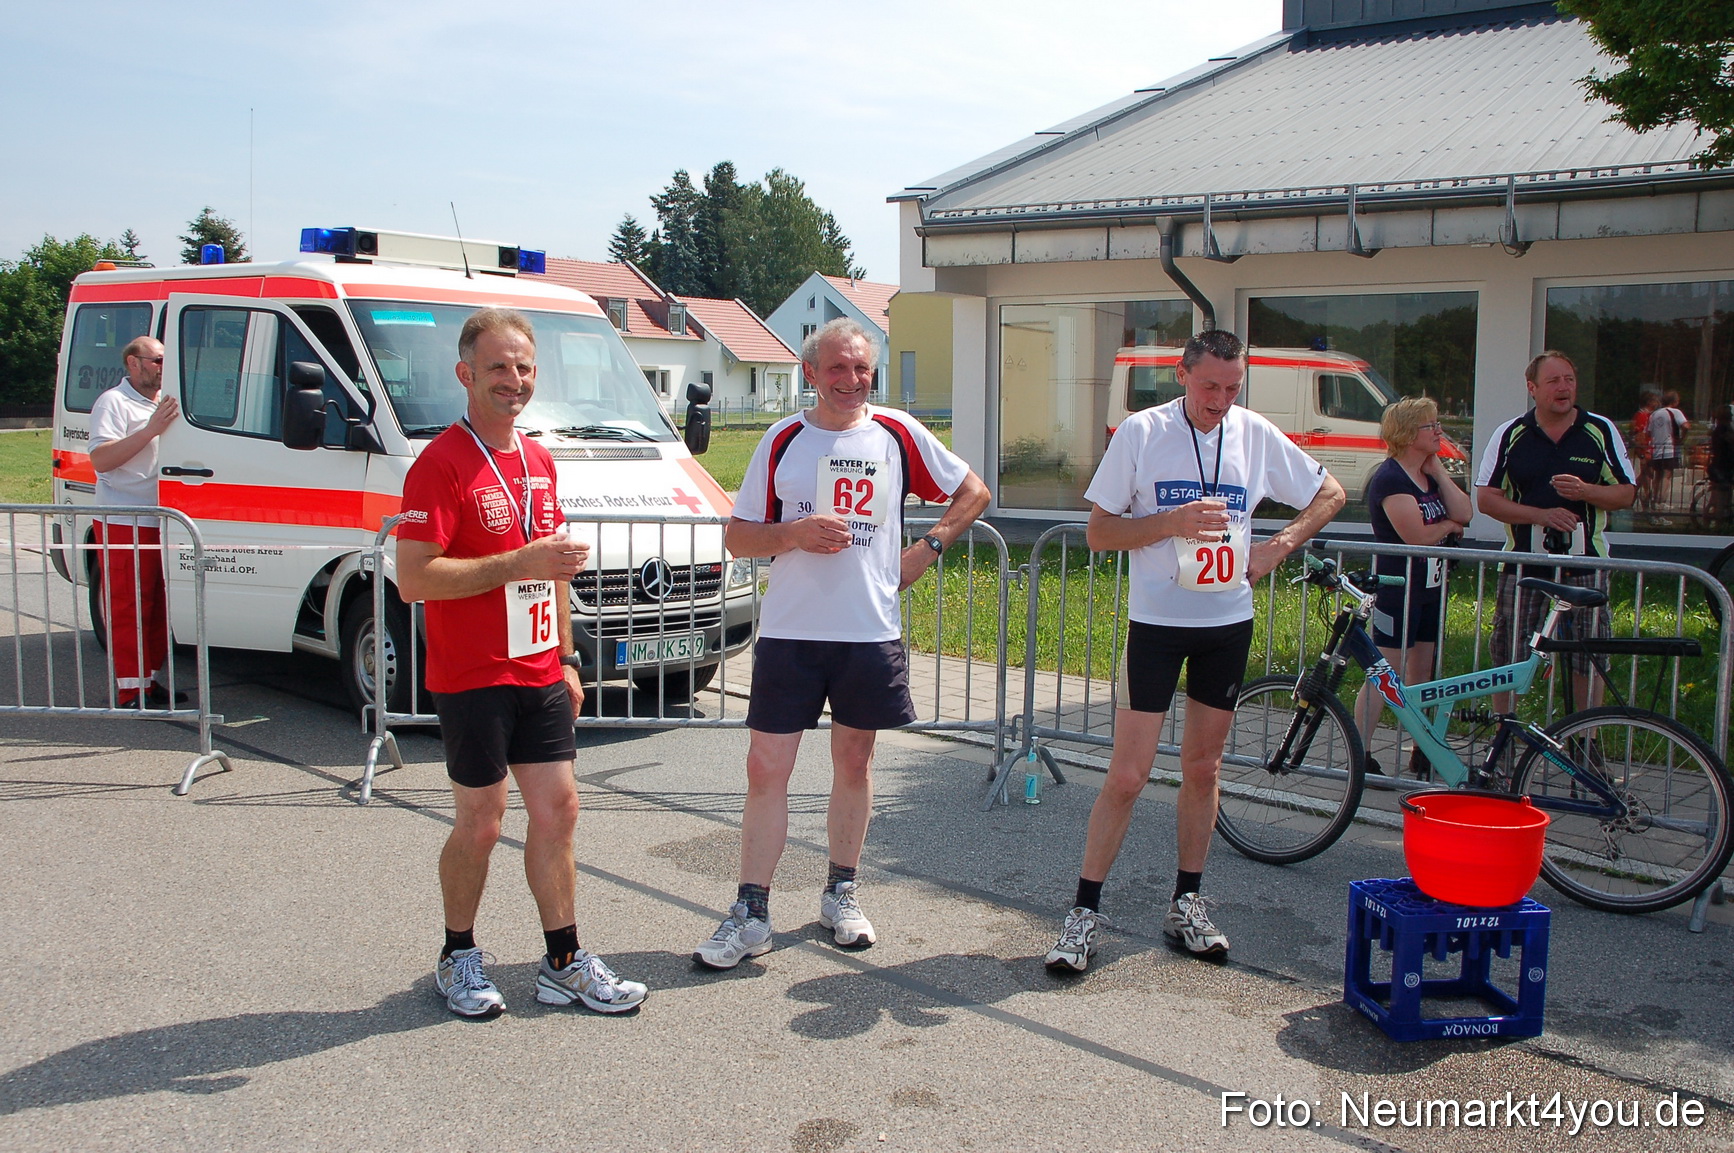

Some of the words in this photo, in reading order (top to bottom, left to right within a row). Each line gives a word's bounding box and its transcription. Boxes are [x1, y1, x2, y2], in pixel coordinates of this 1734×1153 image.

[63, 426, 90, 441] Bayerisches
[829, 459, 863, 468] MEYER
[603, 495, 639, 508] Rotes
[638, 494, 672, 507] Kreuz
[833, 477, 874, 517] 62
[485, 506, 509, 520] NEU
[488, 517, 511, 527] MARKT
[1195, 545, 1235, 585] 20
[518, 582, 547, 594] MEYER
[529, 600, 551, 645] 15
[1420, 670, 1514, 702] Bianchi
[1542, 750, 1576, 776] Bianchi
[1463, 917, 1478, 928] 1.0
[1488, 917, 1499, 927] 12
